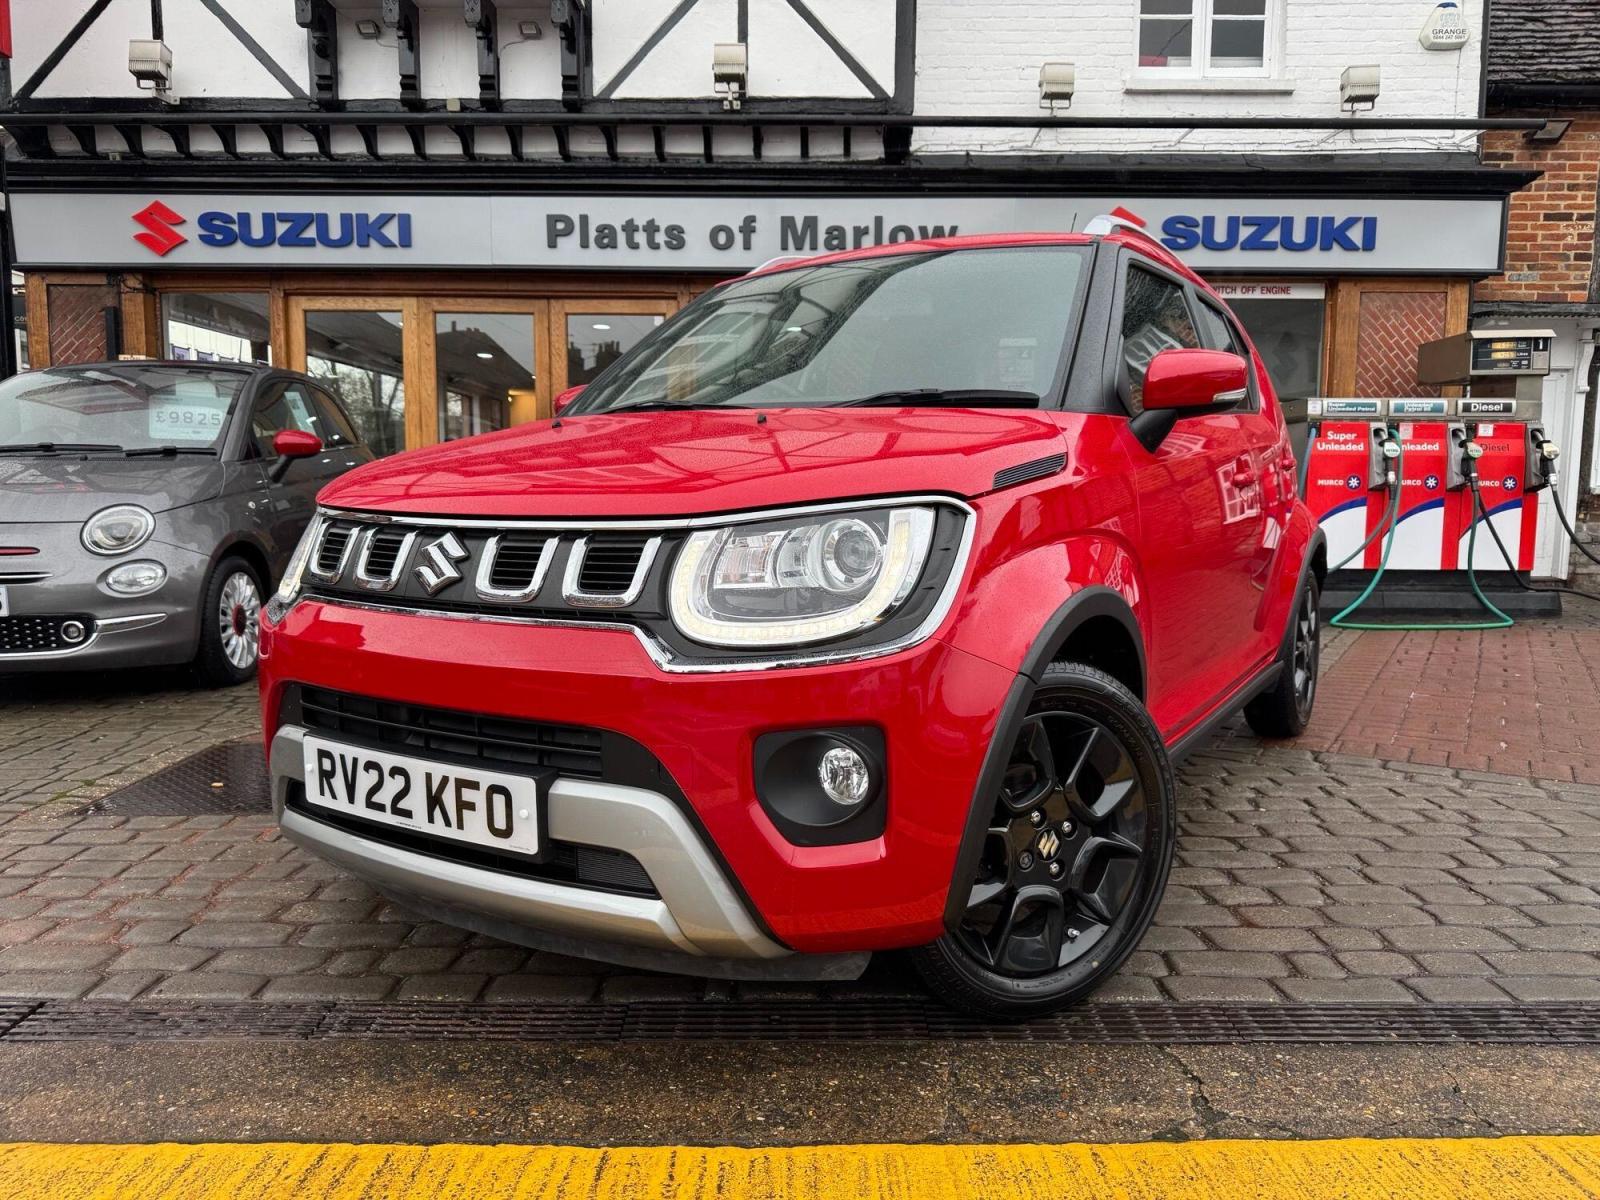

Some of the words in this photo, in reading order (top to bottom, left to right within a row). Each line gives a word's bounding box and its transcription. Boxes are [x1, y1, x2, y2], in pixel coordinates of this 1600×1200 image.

[197, 211, 412, 248] SUZUKI
[546, 214, 686, 249] Platts
[709, 215, 756, 250] of
[1161, 215, 1378, 251] SUZUKI
[1240, 286, 1256, 294] OFF
[1260, 286, 1291, 294] ENGINE
[1538, 338, 1543, 350] 1
[1471, 403, 1503, 412] Diesel
[156, 411, 221, 425] £9825
[1327, 431, 1357, 442] Super
[1316, 442, 1364, 451] Unleaded
[1402, 442, 1439, 450] nleaded
[1480, 443, 1510, 452] Diesel
[317, 748, 413, 820] RV22
[425, 771, 514, 840] KFO
